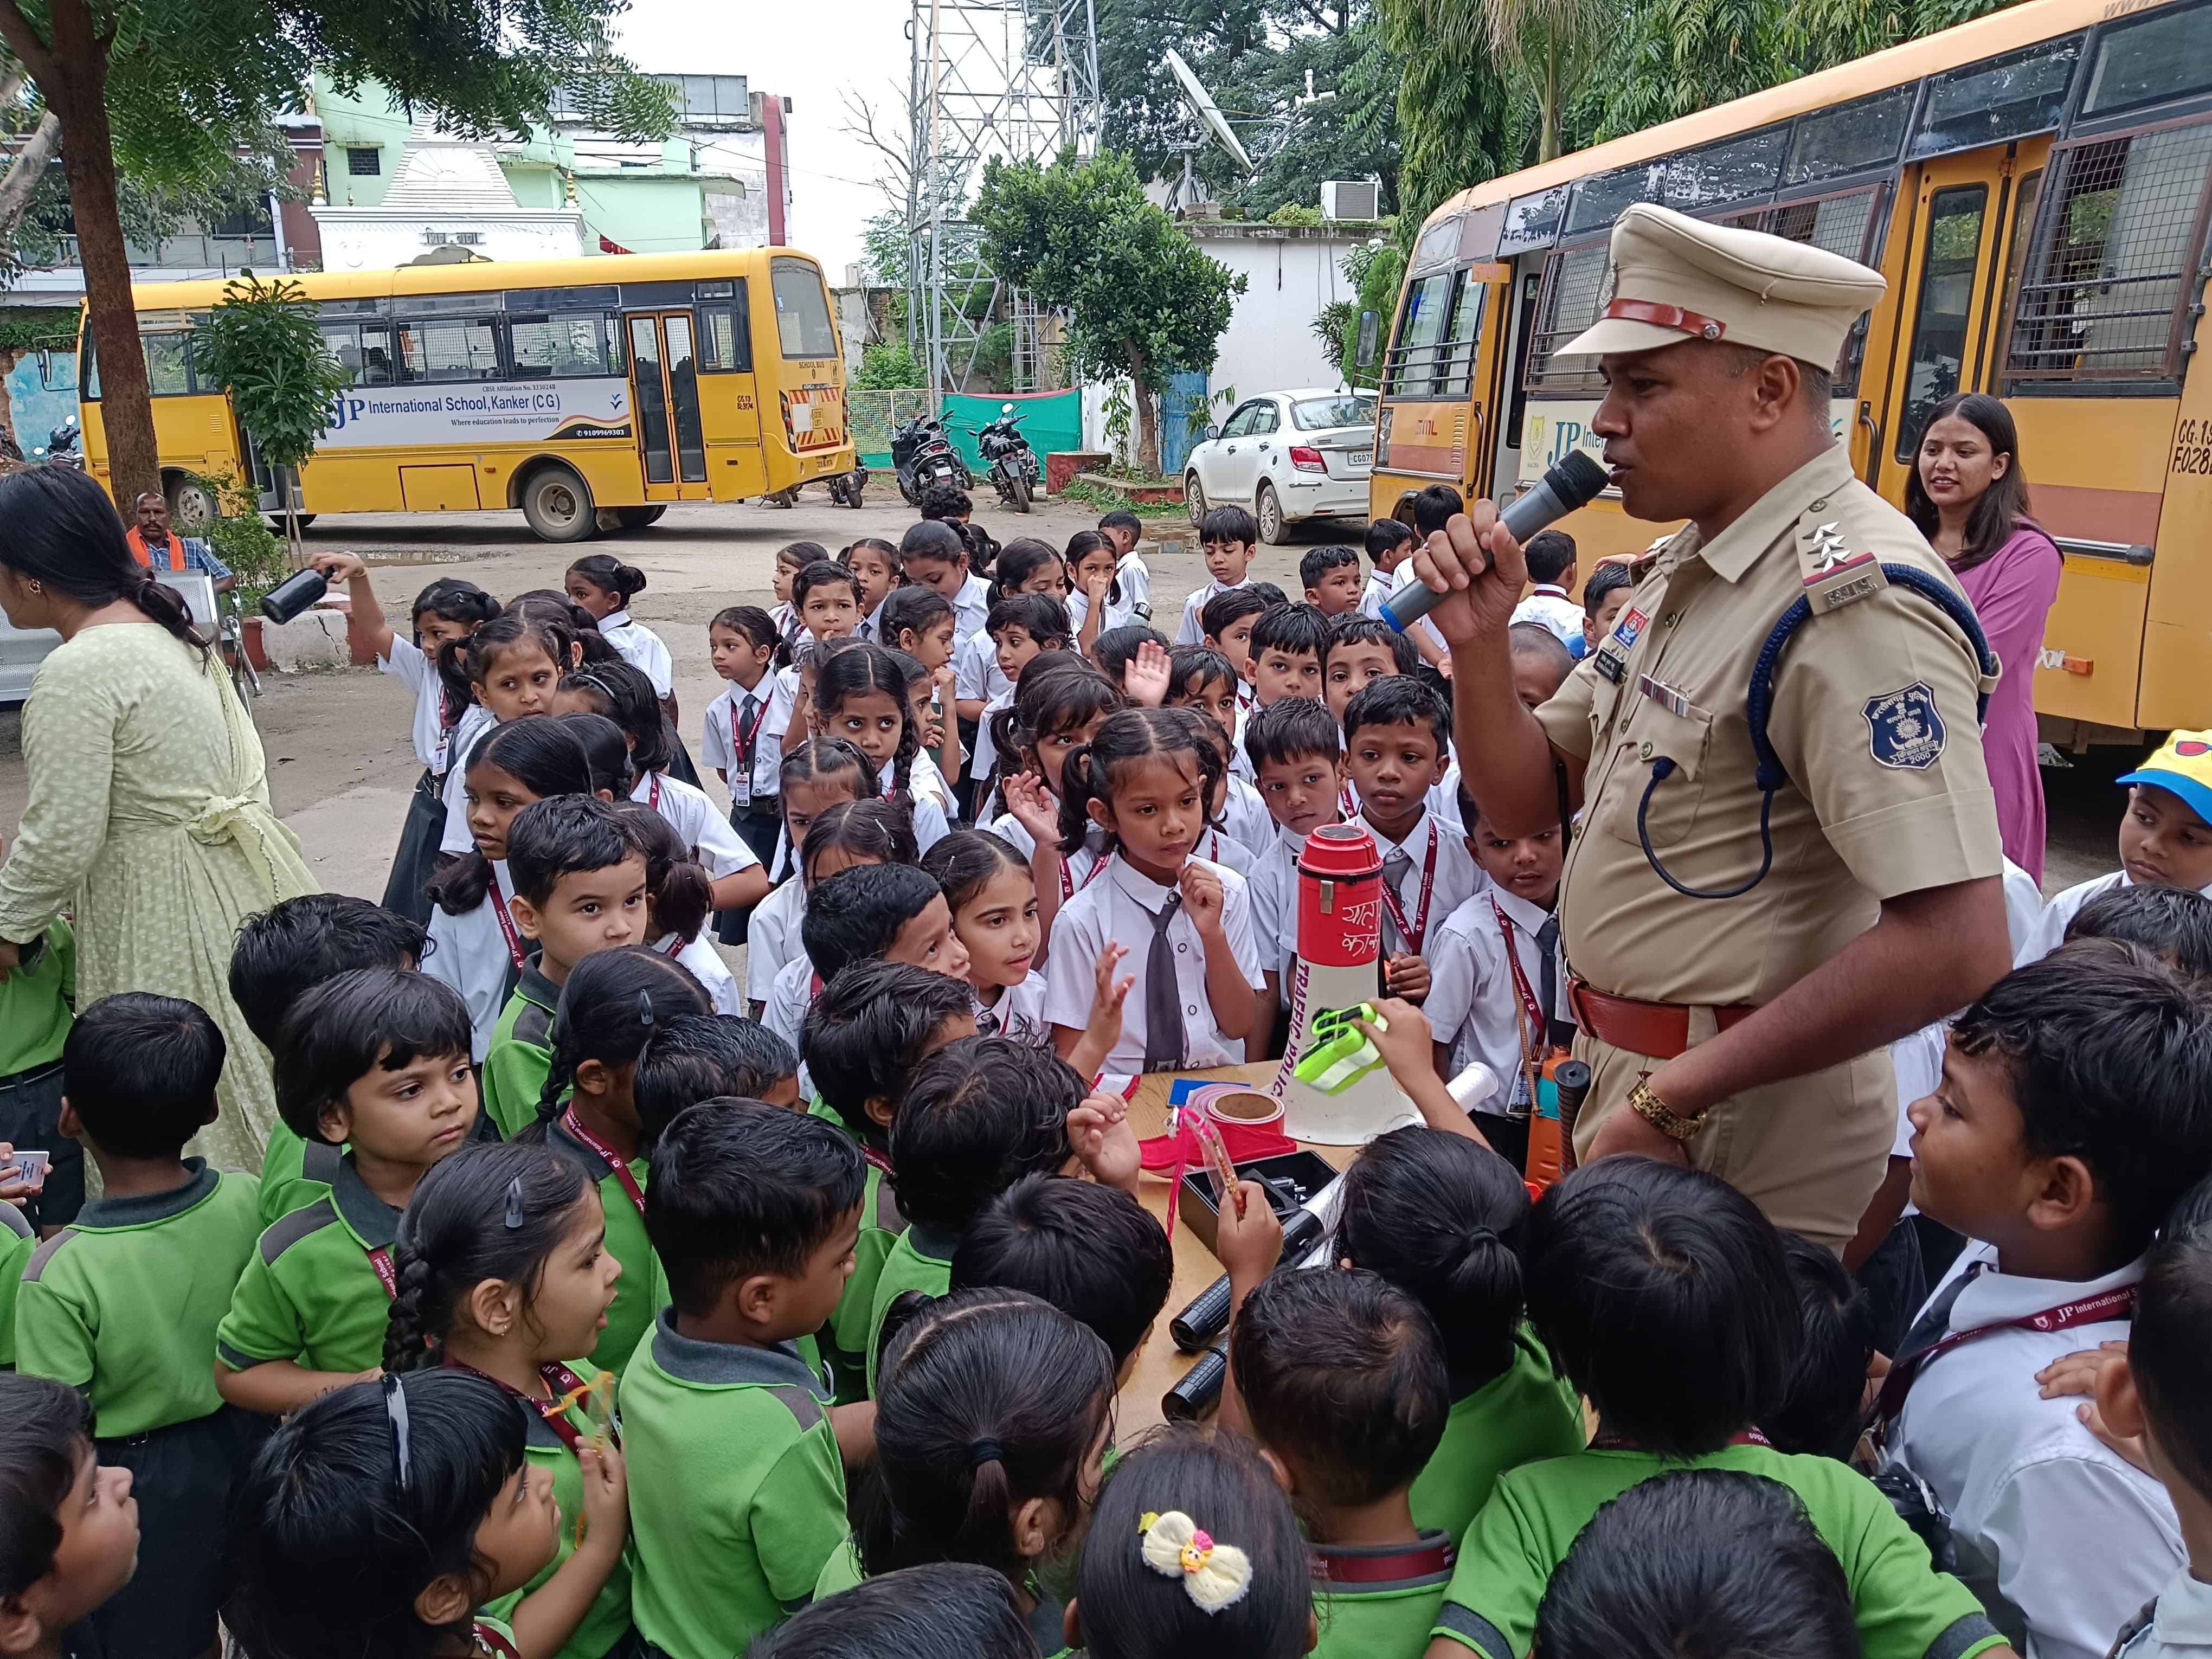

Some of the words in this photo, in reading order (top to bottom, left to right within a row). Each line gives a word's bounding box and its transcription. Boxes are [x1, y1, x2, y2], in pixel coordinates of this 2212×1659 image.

[331, 399, 365, 429] JP
[369, 397, 442, 414] International
[491, 395, 529, 409] Kanker
[528, 416, 560, 425] perfection
[1416, 420, 1438, 436] SML
[2172, 446, 2212, 475] F.028
[1909, 752, 1931, 764] 2000
[1417, 912, 1423, 921] JP
[1290, 963, 1310, 1040] TRAFFIC
[1271, 1040, 1298, 1097] POLIC
[575, 1127, 603, 1153] International
[600, 1149, 613, 1158] JP
[374, 1258, 389, 1278] School
[2057, 1306, 2074, 1323] JP
[2075, 1290, 2130, 1314] International
